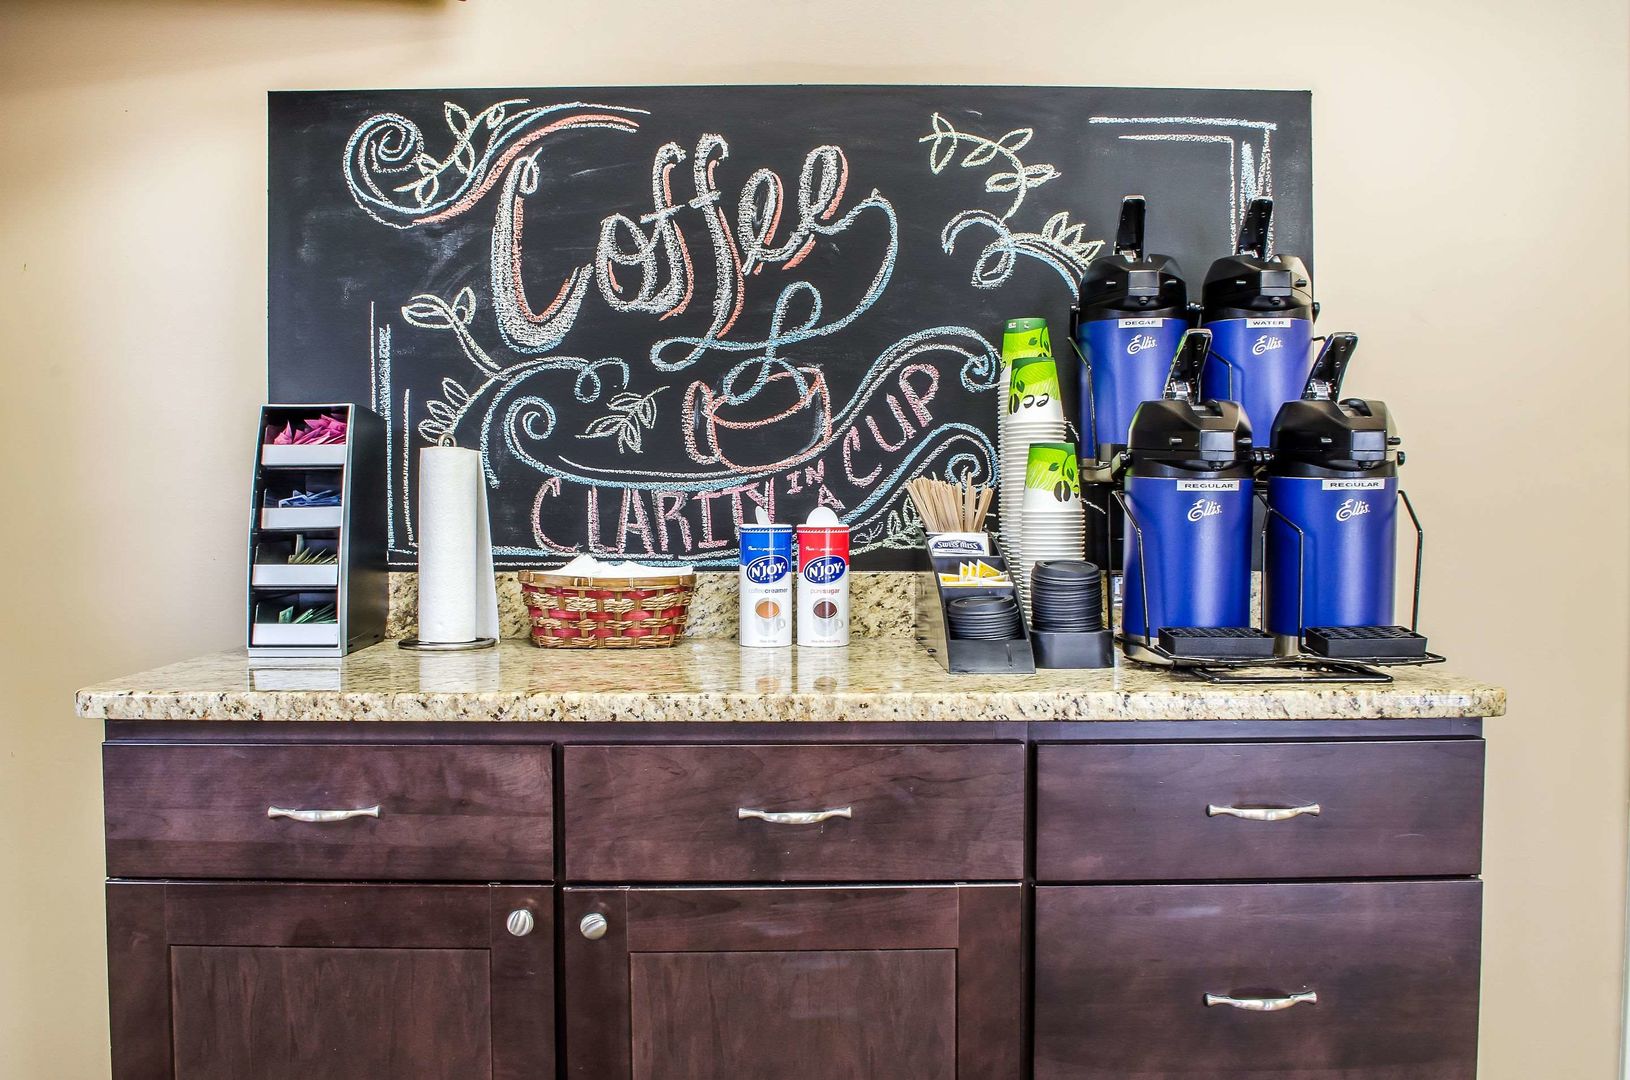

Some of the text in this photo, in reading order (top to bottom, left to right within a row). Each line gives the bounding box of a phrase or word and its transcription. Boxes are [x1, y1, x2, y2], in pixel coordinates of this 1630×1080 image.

[491, 132, 898, 354] Coffee
[530, 363, 940, 555] CLARITY IN A CUP
